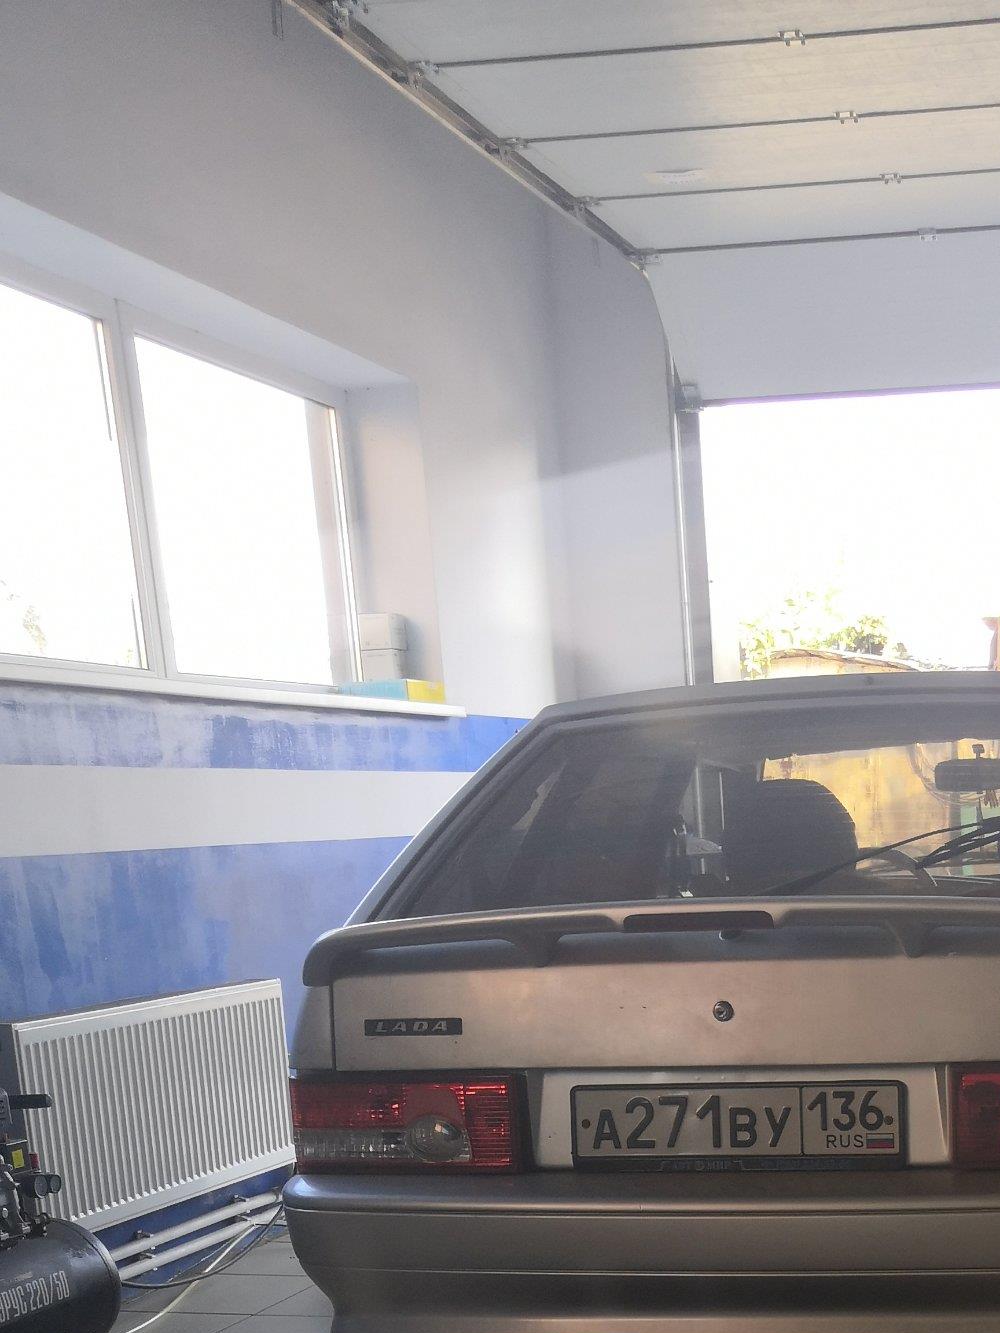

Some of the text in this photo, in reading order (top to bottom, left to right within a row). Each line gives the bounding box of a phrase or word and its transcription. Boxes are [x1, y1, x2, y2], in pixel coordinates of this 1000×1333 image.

[375, 1020, 449, 1033] LADA
[807, 1090, 886, 1132] 136
[825, 1134, 865, 1149] RUS
[26, 1270, 70, 1311] 220/50
